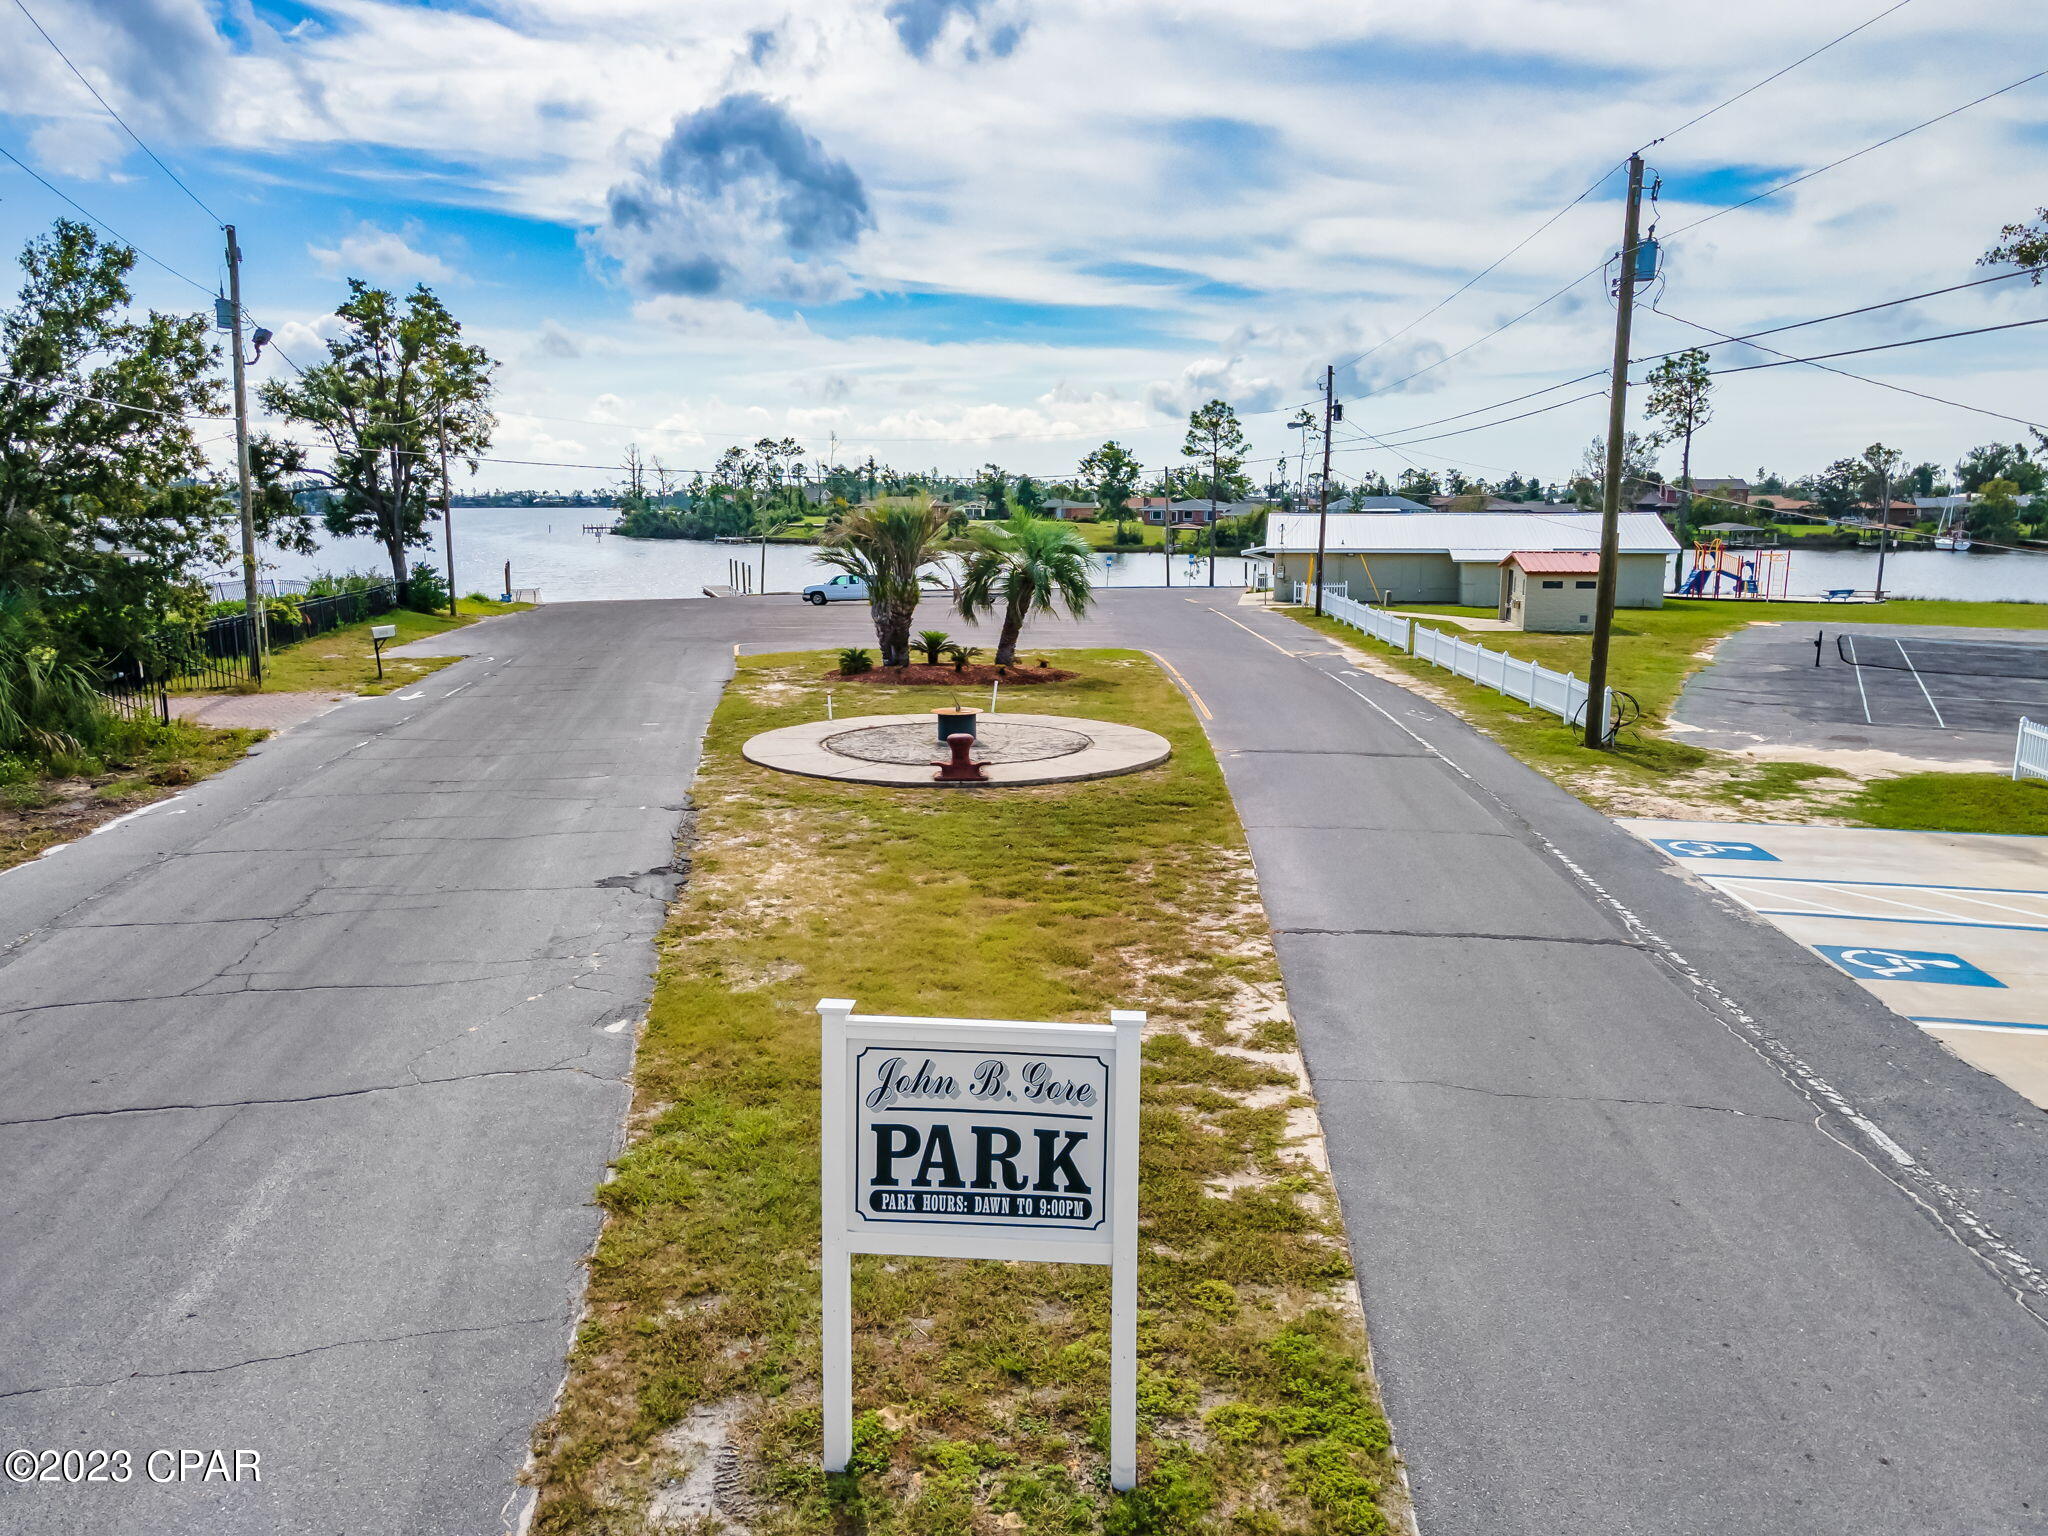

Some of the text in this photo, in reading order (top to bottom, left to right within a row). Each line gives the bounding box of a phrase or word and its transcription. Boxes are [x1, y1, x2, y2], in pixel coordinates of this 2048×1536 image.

[865, 1057, 1094, 1110] John B. Gore
[870, 1123, 1092, 1194] PARK
[881, 1193, 1084, 1217] PARK HOURS: DAWN TO 9:00PM
